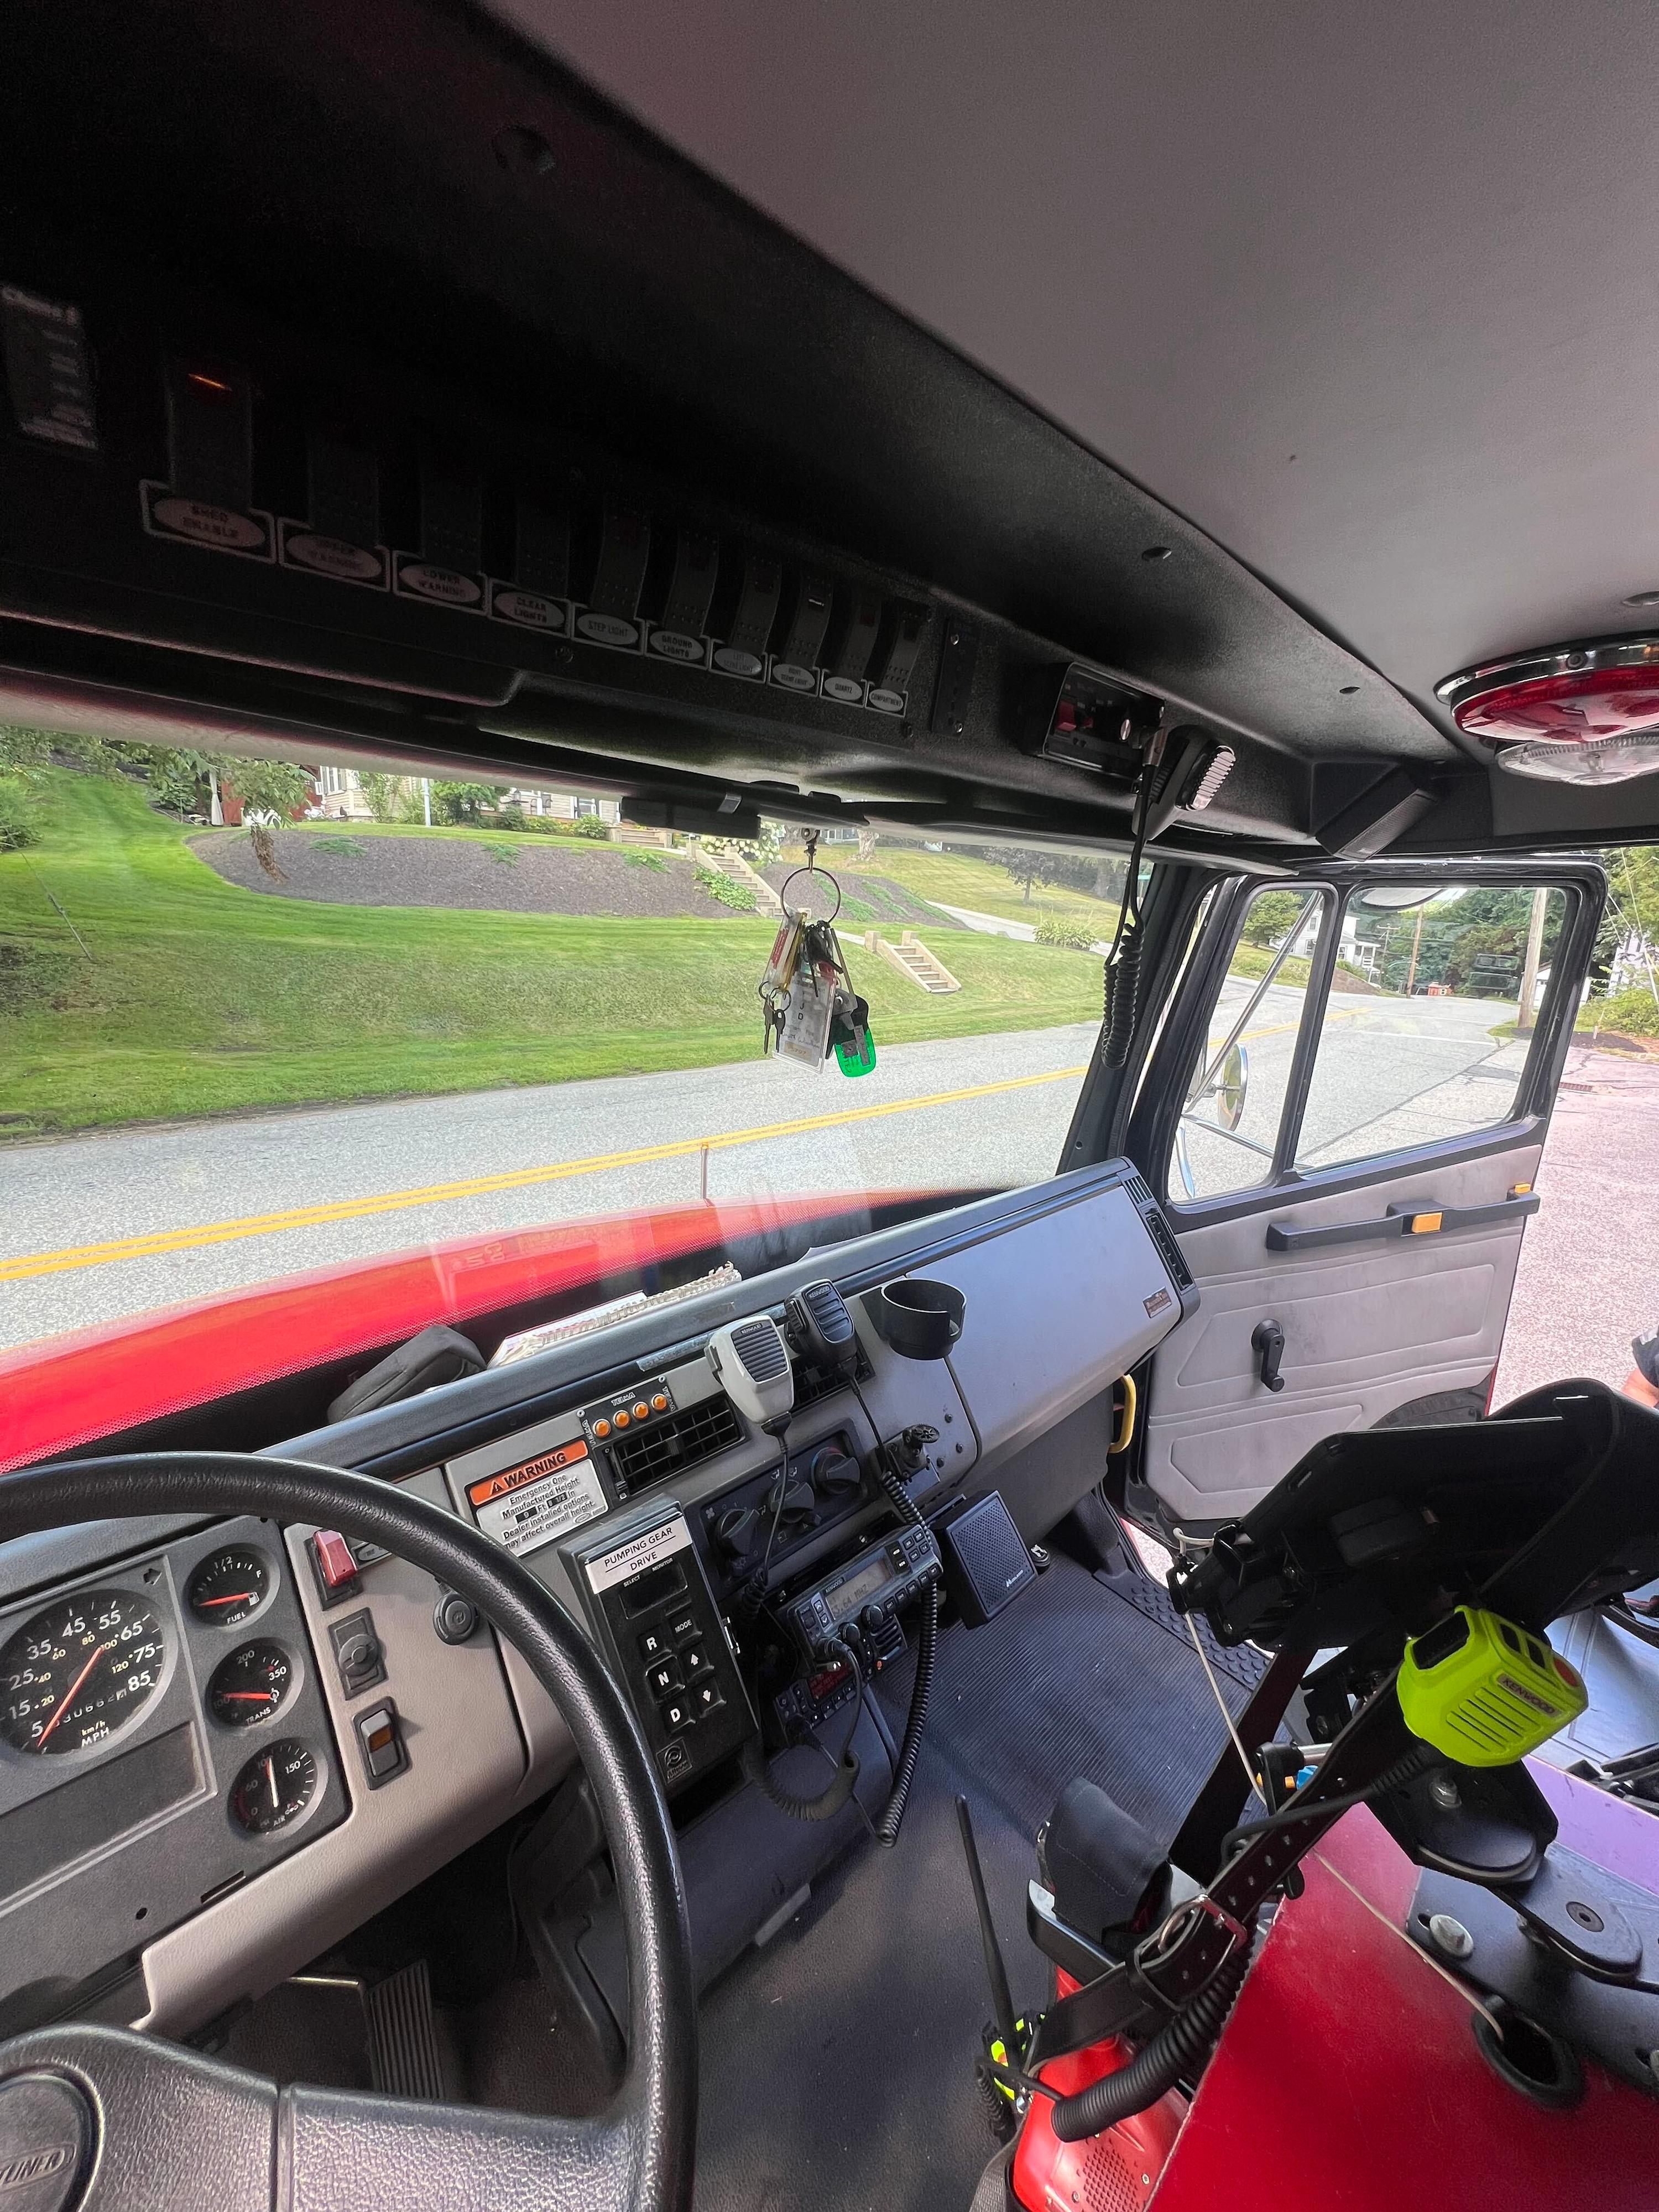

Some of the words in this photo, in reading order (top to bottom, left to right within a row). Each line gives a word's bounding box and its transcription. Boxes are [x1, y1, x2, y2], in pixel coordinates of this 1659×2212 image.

[517, 597, 547, 609] CLEAR
[514, 609, 548, 624] LIGHTS
[587, 620, 606, 632] STEP
[608, 624, 629, 637] LIGHT
[661, 634, 693, 649] GROUND
[662, 644, 690, 658] LIGHTS
[834, 683, 853, 695] QUARTZ
[870, 692, 902, 707] COMPARTMENT
[809, 1286, 831, 1299] KENWOOD
[504, 1451, 566, 1488] WARNING
[509, 1481, 551, 1505] Emergency
[552, 1474, 567, 1485] One
[502, 1490, 554, 1519] Manufactured
[555, 1478, 580, 1494] Height
[537, 1503, 546, 1513] Ft
[555, 1495, 566, 1504] 1/2
[503, 1524, 529, 1540] Dealer
[563, 1494, 589, 1511] options
[504, 1538, 520, 1550] may
[521, 1527, 545, 1541] affect
[546, 1515, 569, 1529] overall
[604, 1540, 646, 1567] PUMPING
[648, 1527, 673, 1548] GEAR
[215, 1556, 233, 1569] 1/2
[629, 1551, 658, 1571] DRIVE
[651, 1557, 674, 1572] MONITOR
[256, 1569, 263, 1579] F
[623, 1574, 641, 1588] SELECT
[98, 1609, 121, 1630] 55
[227, 1611, 247, 1624] FUEL
[61, 1616, 86, 1637] 45
[121, 1621, 143, 1641] 65
[674, 1619, 693, 1633] MODE
[82, 1635, 96, 1646] 80
[646, 1636, 658, 1651] R
[27, 1639, 51, 1660] 35
[52, 1648, 66, 1661] 60
[133, 1642, 156, 1663] 75
[236, 1650, 255, 1665] 200
[111, 1661, 129, 1673] 120
[268, 1666, 287, 1681] 350
[8, 1668, 34, 1691] 25
[38, 1672, 52, 1684] 40
[128, 1670, 151, 1692] 85
[658, 1671, 670, 1686] N
[41, 1694, 55, 1707] 20
[1503, 1677, 1556, 1714] KENWOOD
[8, 1699, 30, 1720] 15
[245, 1707, 271, 1725] TRANS
[670, 1708, 681, 1723] D
[32, 1720, 44, 1738] 5
[81, 1720, 106, 1736] km/h
[81, 1726, 110, 1747] MPH
[285, 1760, 301, 1775] 150
[273, 1814, 286, 1827] AIR
